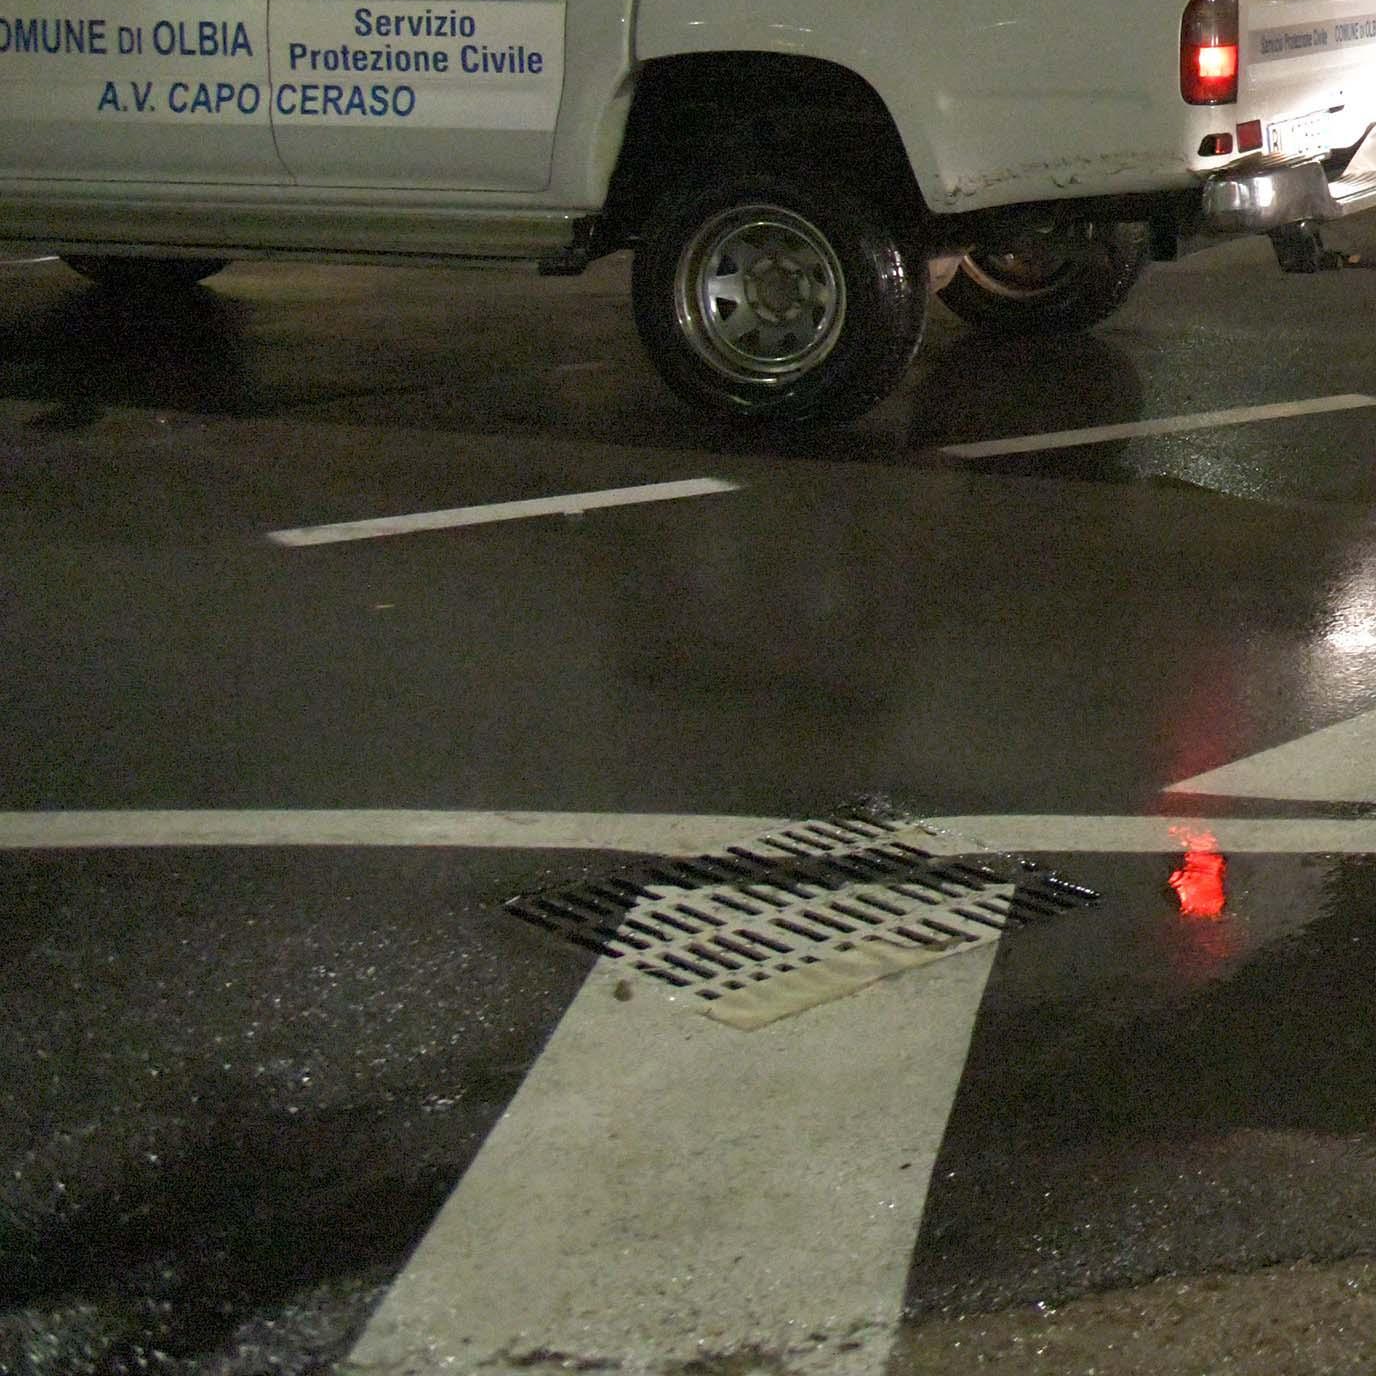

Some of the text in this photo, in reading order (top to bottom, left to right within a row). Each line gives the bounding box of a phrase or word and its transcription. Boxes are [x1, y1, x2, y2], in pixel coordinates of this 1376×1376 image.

[118, 26, 142, 56] DI
[153, 21, 253, 57] OLBIA
[355, 8, 475, 38] Servizio
[290, 43, 543, 75] Protezione Civile
[99, 81, 416, 116] A.V. CAPO CERASO
